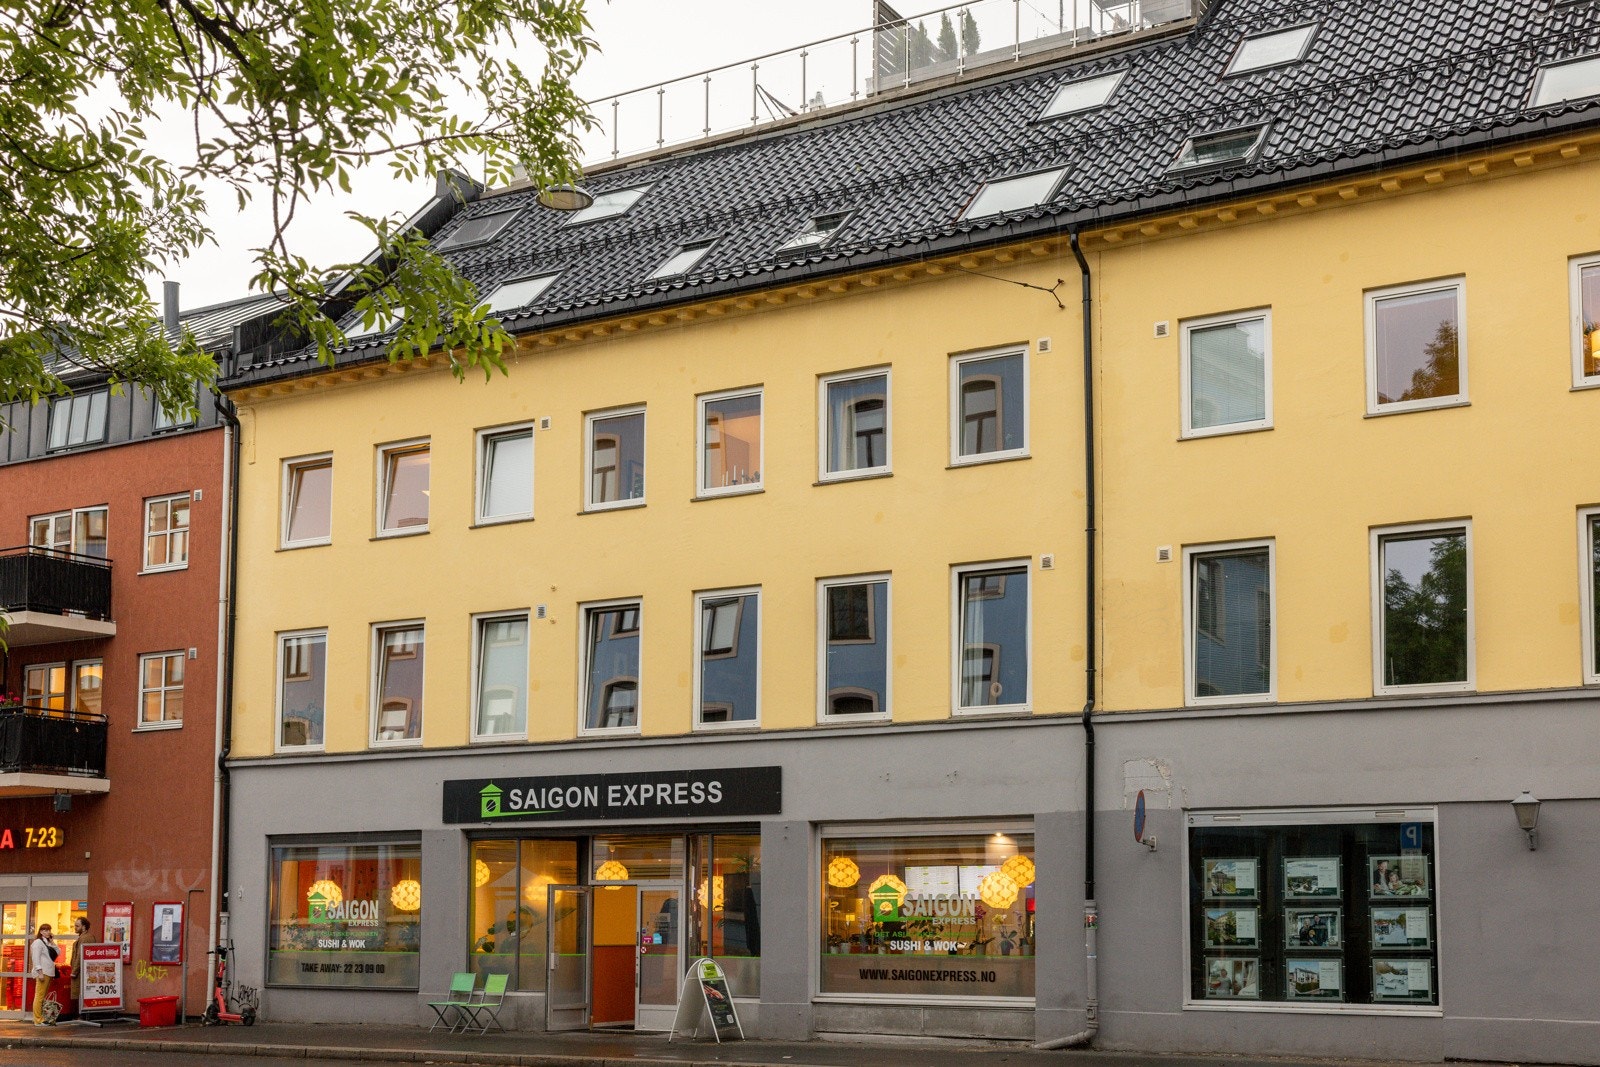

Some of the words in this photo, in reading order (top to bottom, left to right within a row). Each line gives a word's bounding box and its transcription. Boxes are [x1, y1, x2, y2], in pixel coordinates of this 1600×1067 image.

[509, 786, 599, 810] SAIGON
[607, 781, 723, 807] EXPRESS
[26, 827, 57, 847] 7-23
[328, 900, 379, 919] SAIGON
[903, 894, 976, 917] SAIGON
[933, 917, 976, 925] EXPRESS
[318, 939, 339, 948] SUSHI
[341, 940, 347, 948] &
[349, 940, 366, 948] WOK
[890, 941, 921, 950] SUSHI
[924, 941, 932, 950] &
[934, 941, 957, 951] WOK
[301, 963, 318, 973] TAKE
[320, 963, 342, 973] AWAY:
[344, 963, 353, 973] 22
[355, 963, 364, 973] 23
[859, 969, 996, 982] WWW.SAIGONEXPRESS.NO
[96, 985, 117, 995] -30%
